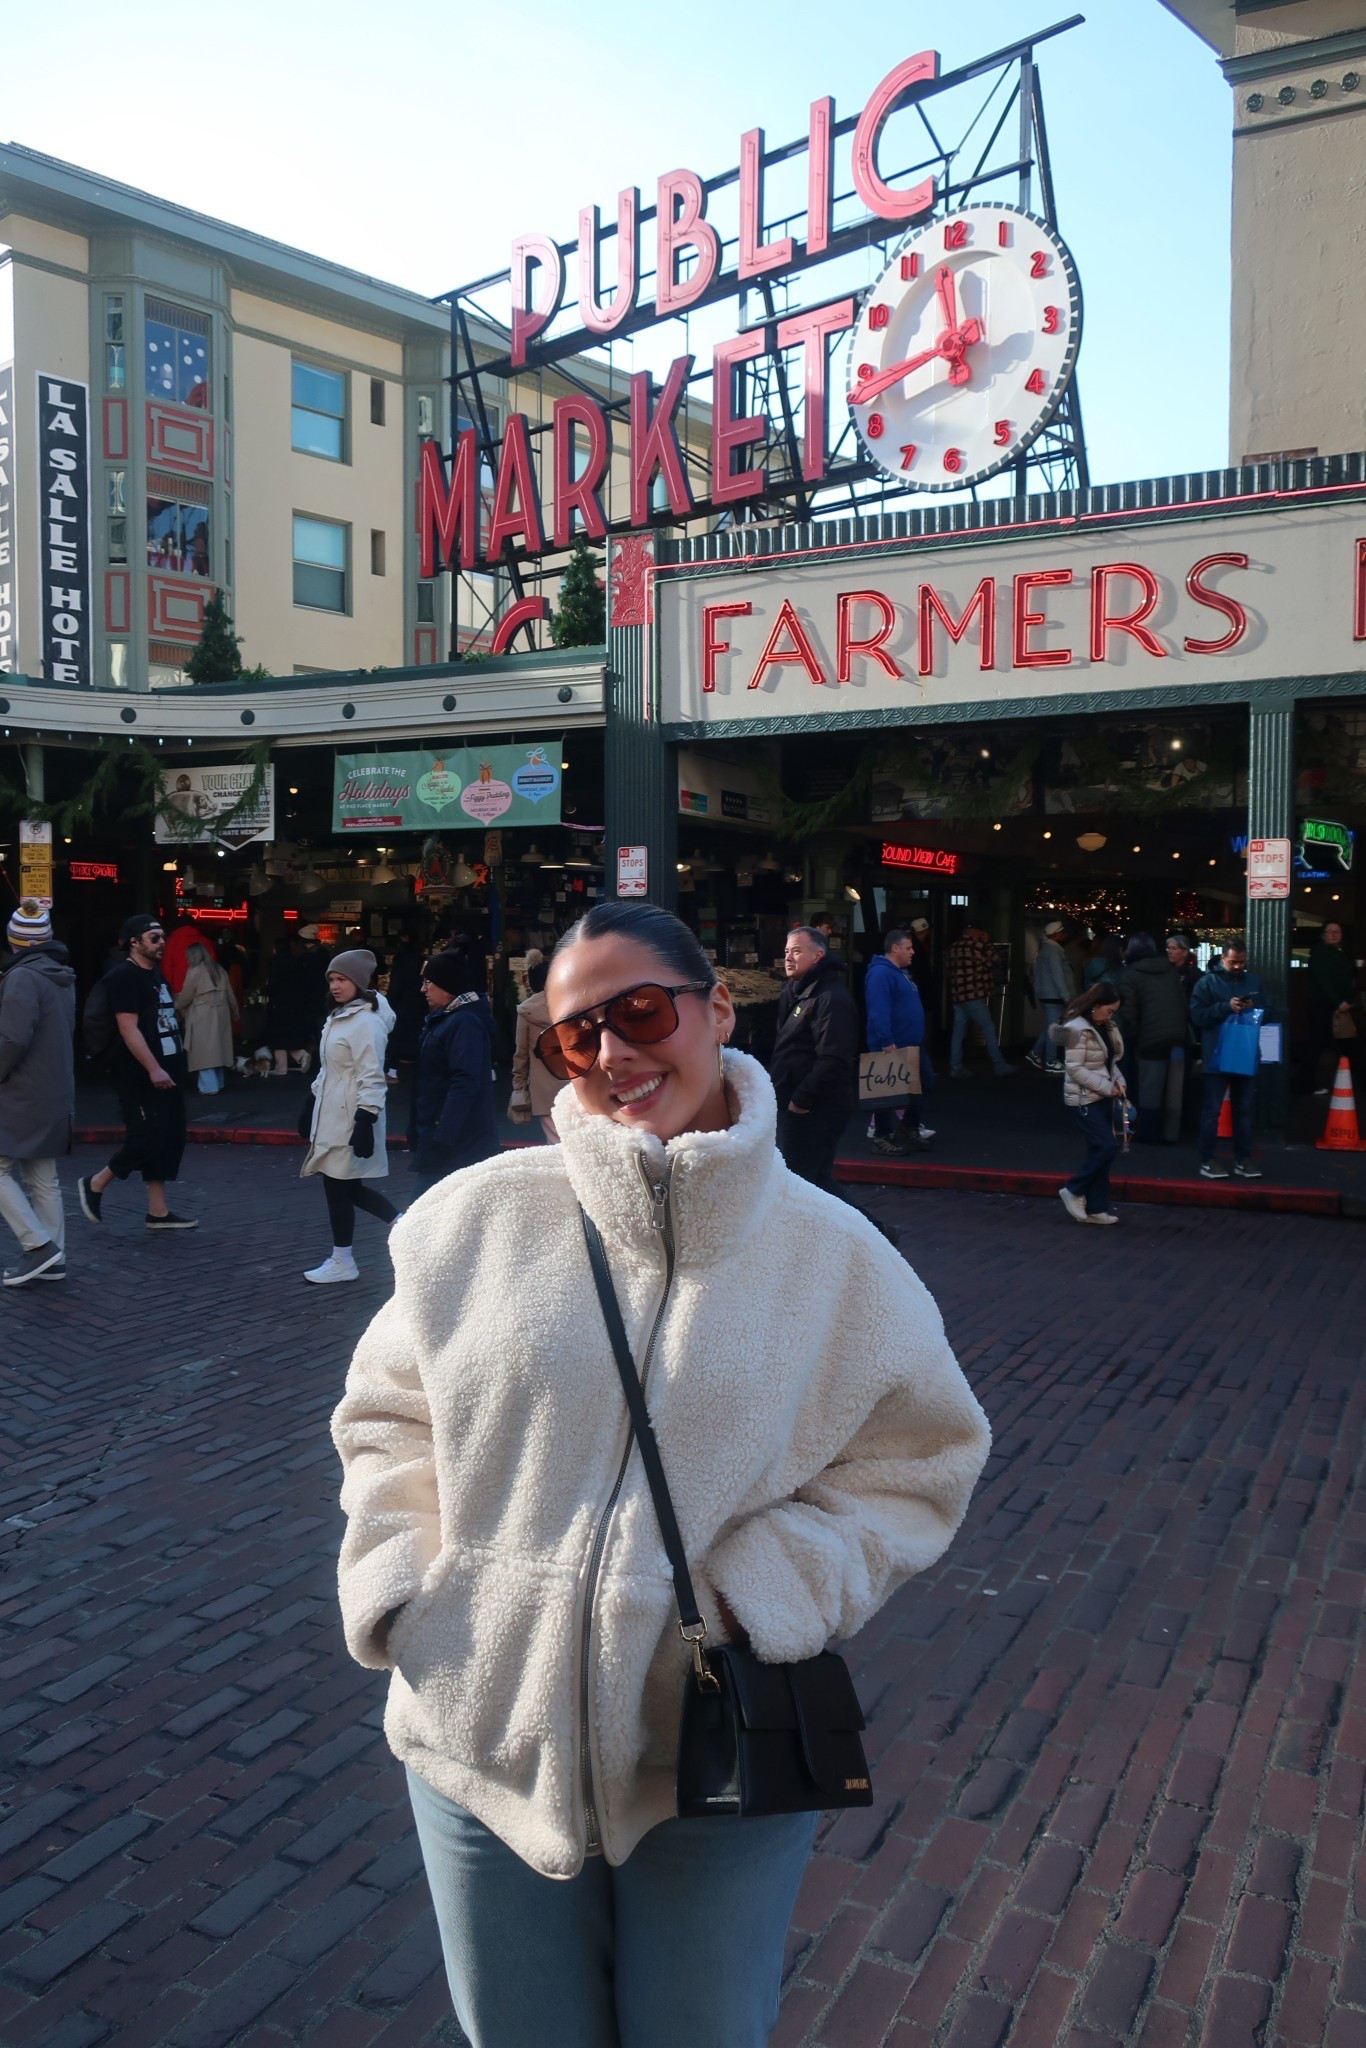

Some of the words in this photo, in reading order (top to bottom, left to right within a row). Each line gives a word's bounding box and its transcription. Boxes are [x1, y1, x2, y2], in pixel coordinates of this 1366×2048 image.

[511, 50, 940, 368] PUBLIC
[944, 221, 968, 250] 12
[999, 221, 1008, 247] 1
[901, 253, 918, 281] 11
[1031, 251, 1047, 278] 2
[869, 304, 889, 330] 10
[1042, 305, 1059, 334] 3
[858, 363, 874, 384] 9
[1025, 368, 1044, 395] 4
[47, 382, 79, 437] LA
[419, 298, 854, 578] MARKET
[867, 413, 884, 439] 8
[993, 419, 1010, 446] 5
[900, 444, 917, 470] 7
[943, 448, 961, 472] 6
[48, 448, 79, 574] SALLE
[703, 552, 1248, 693] FARMERS
[201, 774, 229, 791] YOUR
[347, 767, 389, 779] CELEBRATE
[391, 767, 407, 778] THE
[338, 779, 411, 808] Holidays
[469, 793, 486, 803] Figgy
[486, 791, 510, 800] Pudding
[619, 849, 629, 857] NO
[1251, 842, 1263, 851] NO
[1254, 854, 1285, 863] STOPS
[622, 859, 643, 867] STOPS
[859, 1061, 911, 1091] table
